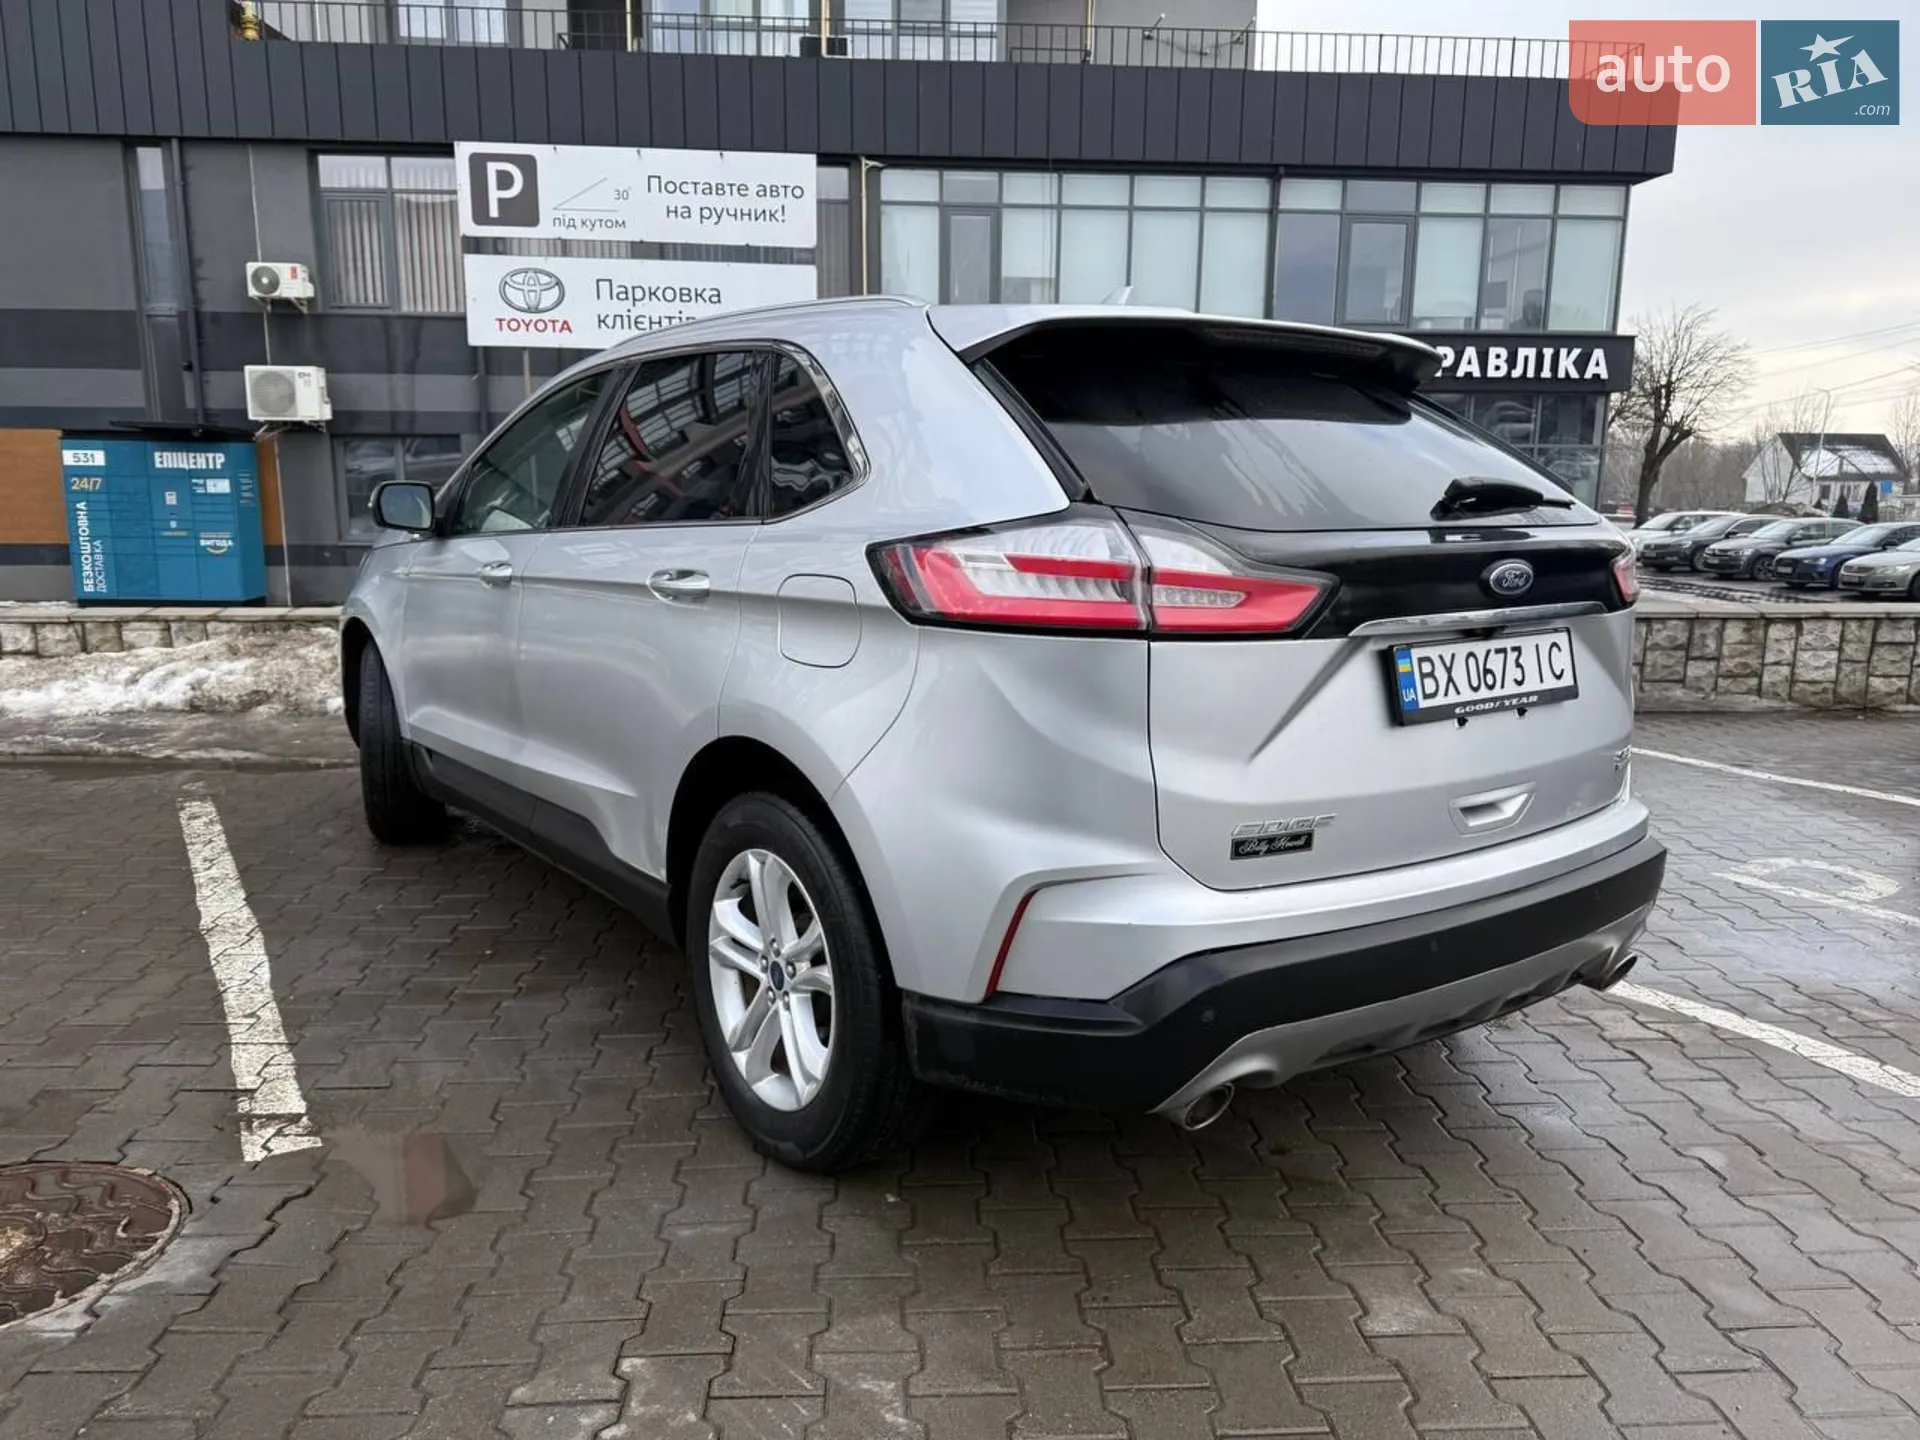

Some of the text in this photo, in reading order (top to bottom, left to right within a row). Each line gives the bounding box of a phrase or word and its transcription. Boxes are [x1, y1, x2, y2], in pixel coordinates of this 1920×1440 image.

[486, 161, 525, 218] P
[647, 175, 805, 200] Поставте авто
[553, 216, 627, 231] під кутом
[666, 204, 786, 225] на ручник!
[595, 279, 722, 307] Парковка
[495, 317, 572, 334] TOYOTA
[597, 308, 697, 331] клієнті
[72, 453, 96, 464] 531
[154, 452, 225, 470] ЕПІЦЕНТР
[70, 477, 103, 492] 24/7
[75, 501, 95, 592] БЕЗКОШТОВНА
[92, 539, 107, 592] ДОСТАВКА
[1501, 569, 1528, 588] Ford
[1417, 652, 1461, 701] BX
[1464, 645, 1526, 693] 0673
[1402, 687, 1417, 702] UA
